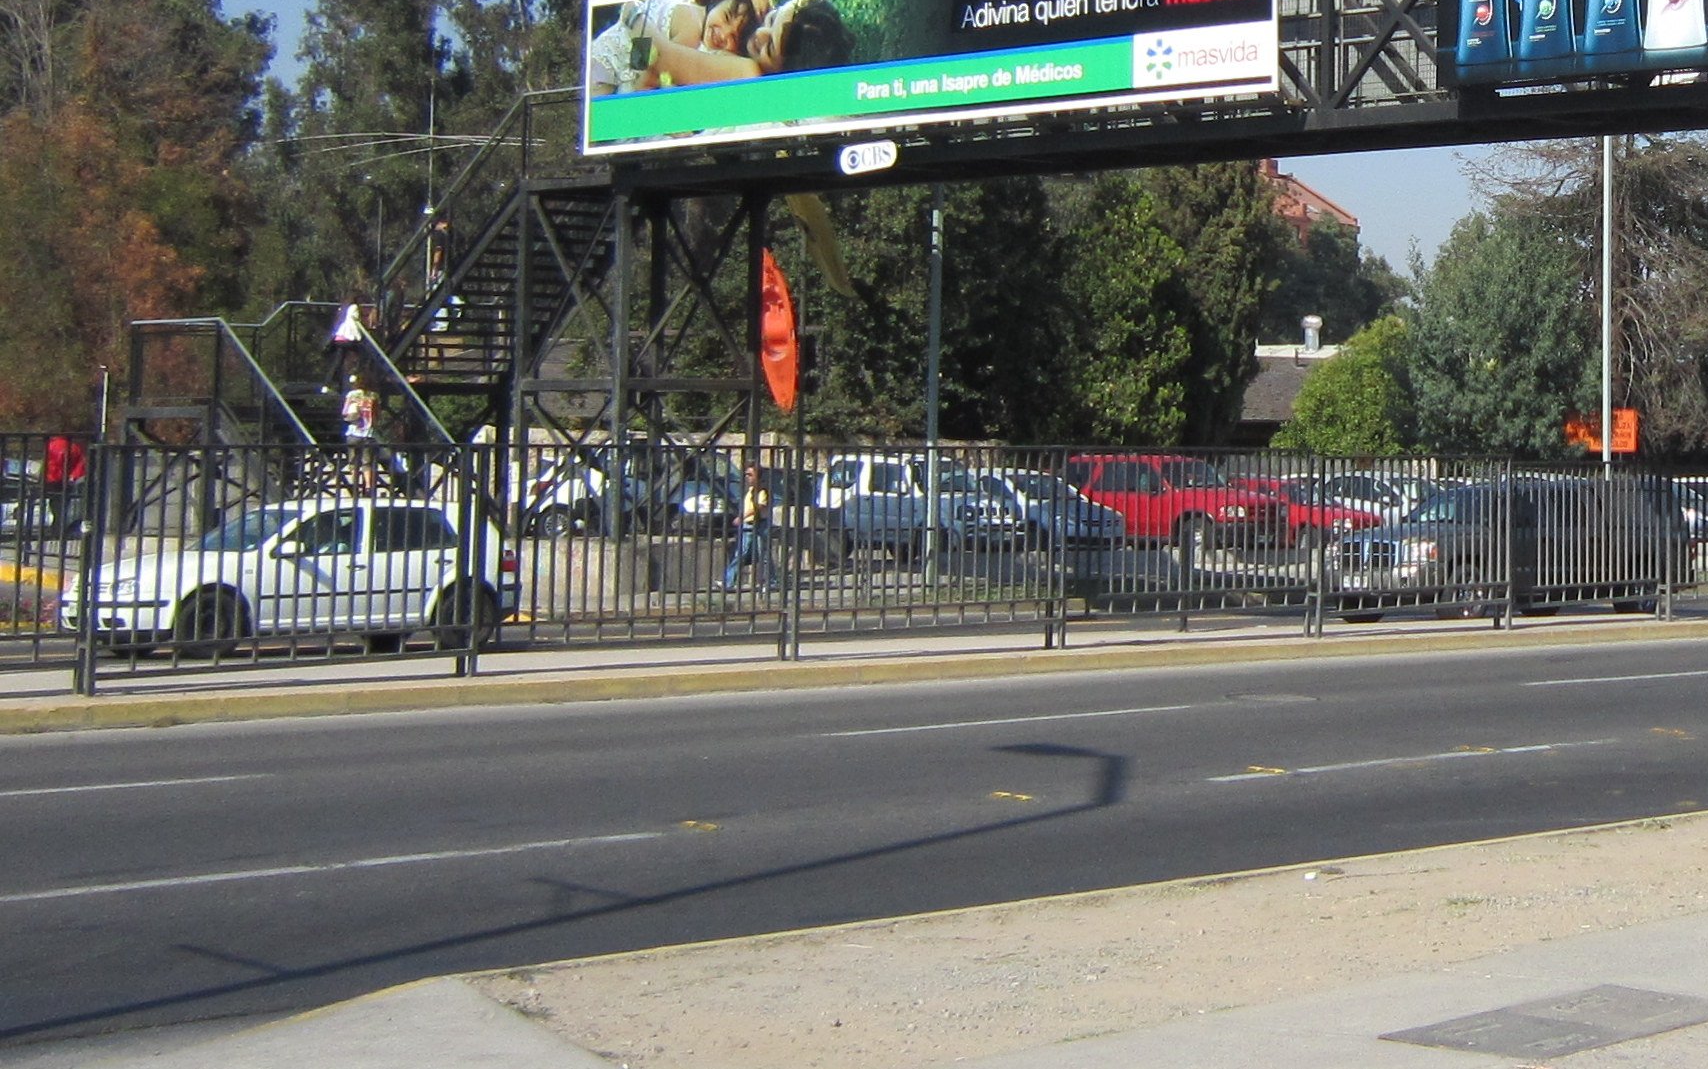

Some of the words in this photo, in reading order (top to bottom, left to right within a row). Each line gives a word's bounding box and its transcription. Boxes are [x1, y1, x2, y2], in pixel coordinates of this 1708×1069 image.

[960, 2, 1030, 29] Adivina
[1177, 40, 1259, 69] masvida
[857, 81, 890, 100] Para
[893, 77, 907, 99] ti,
[911, 79, 938, 95] una
[942, 73, 989, 95] Isapre
[992, 68, 1011, 87] de
[1015, 62, 1082, 85] Médicos
[861, 143, 892, 167] CBS
